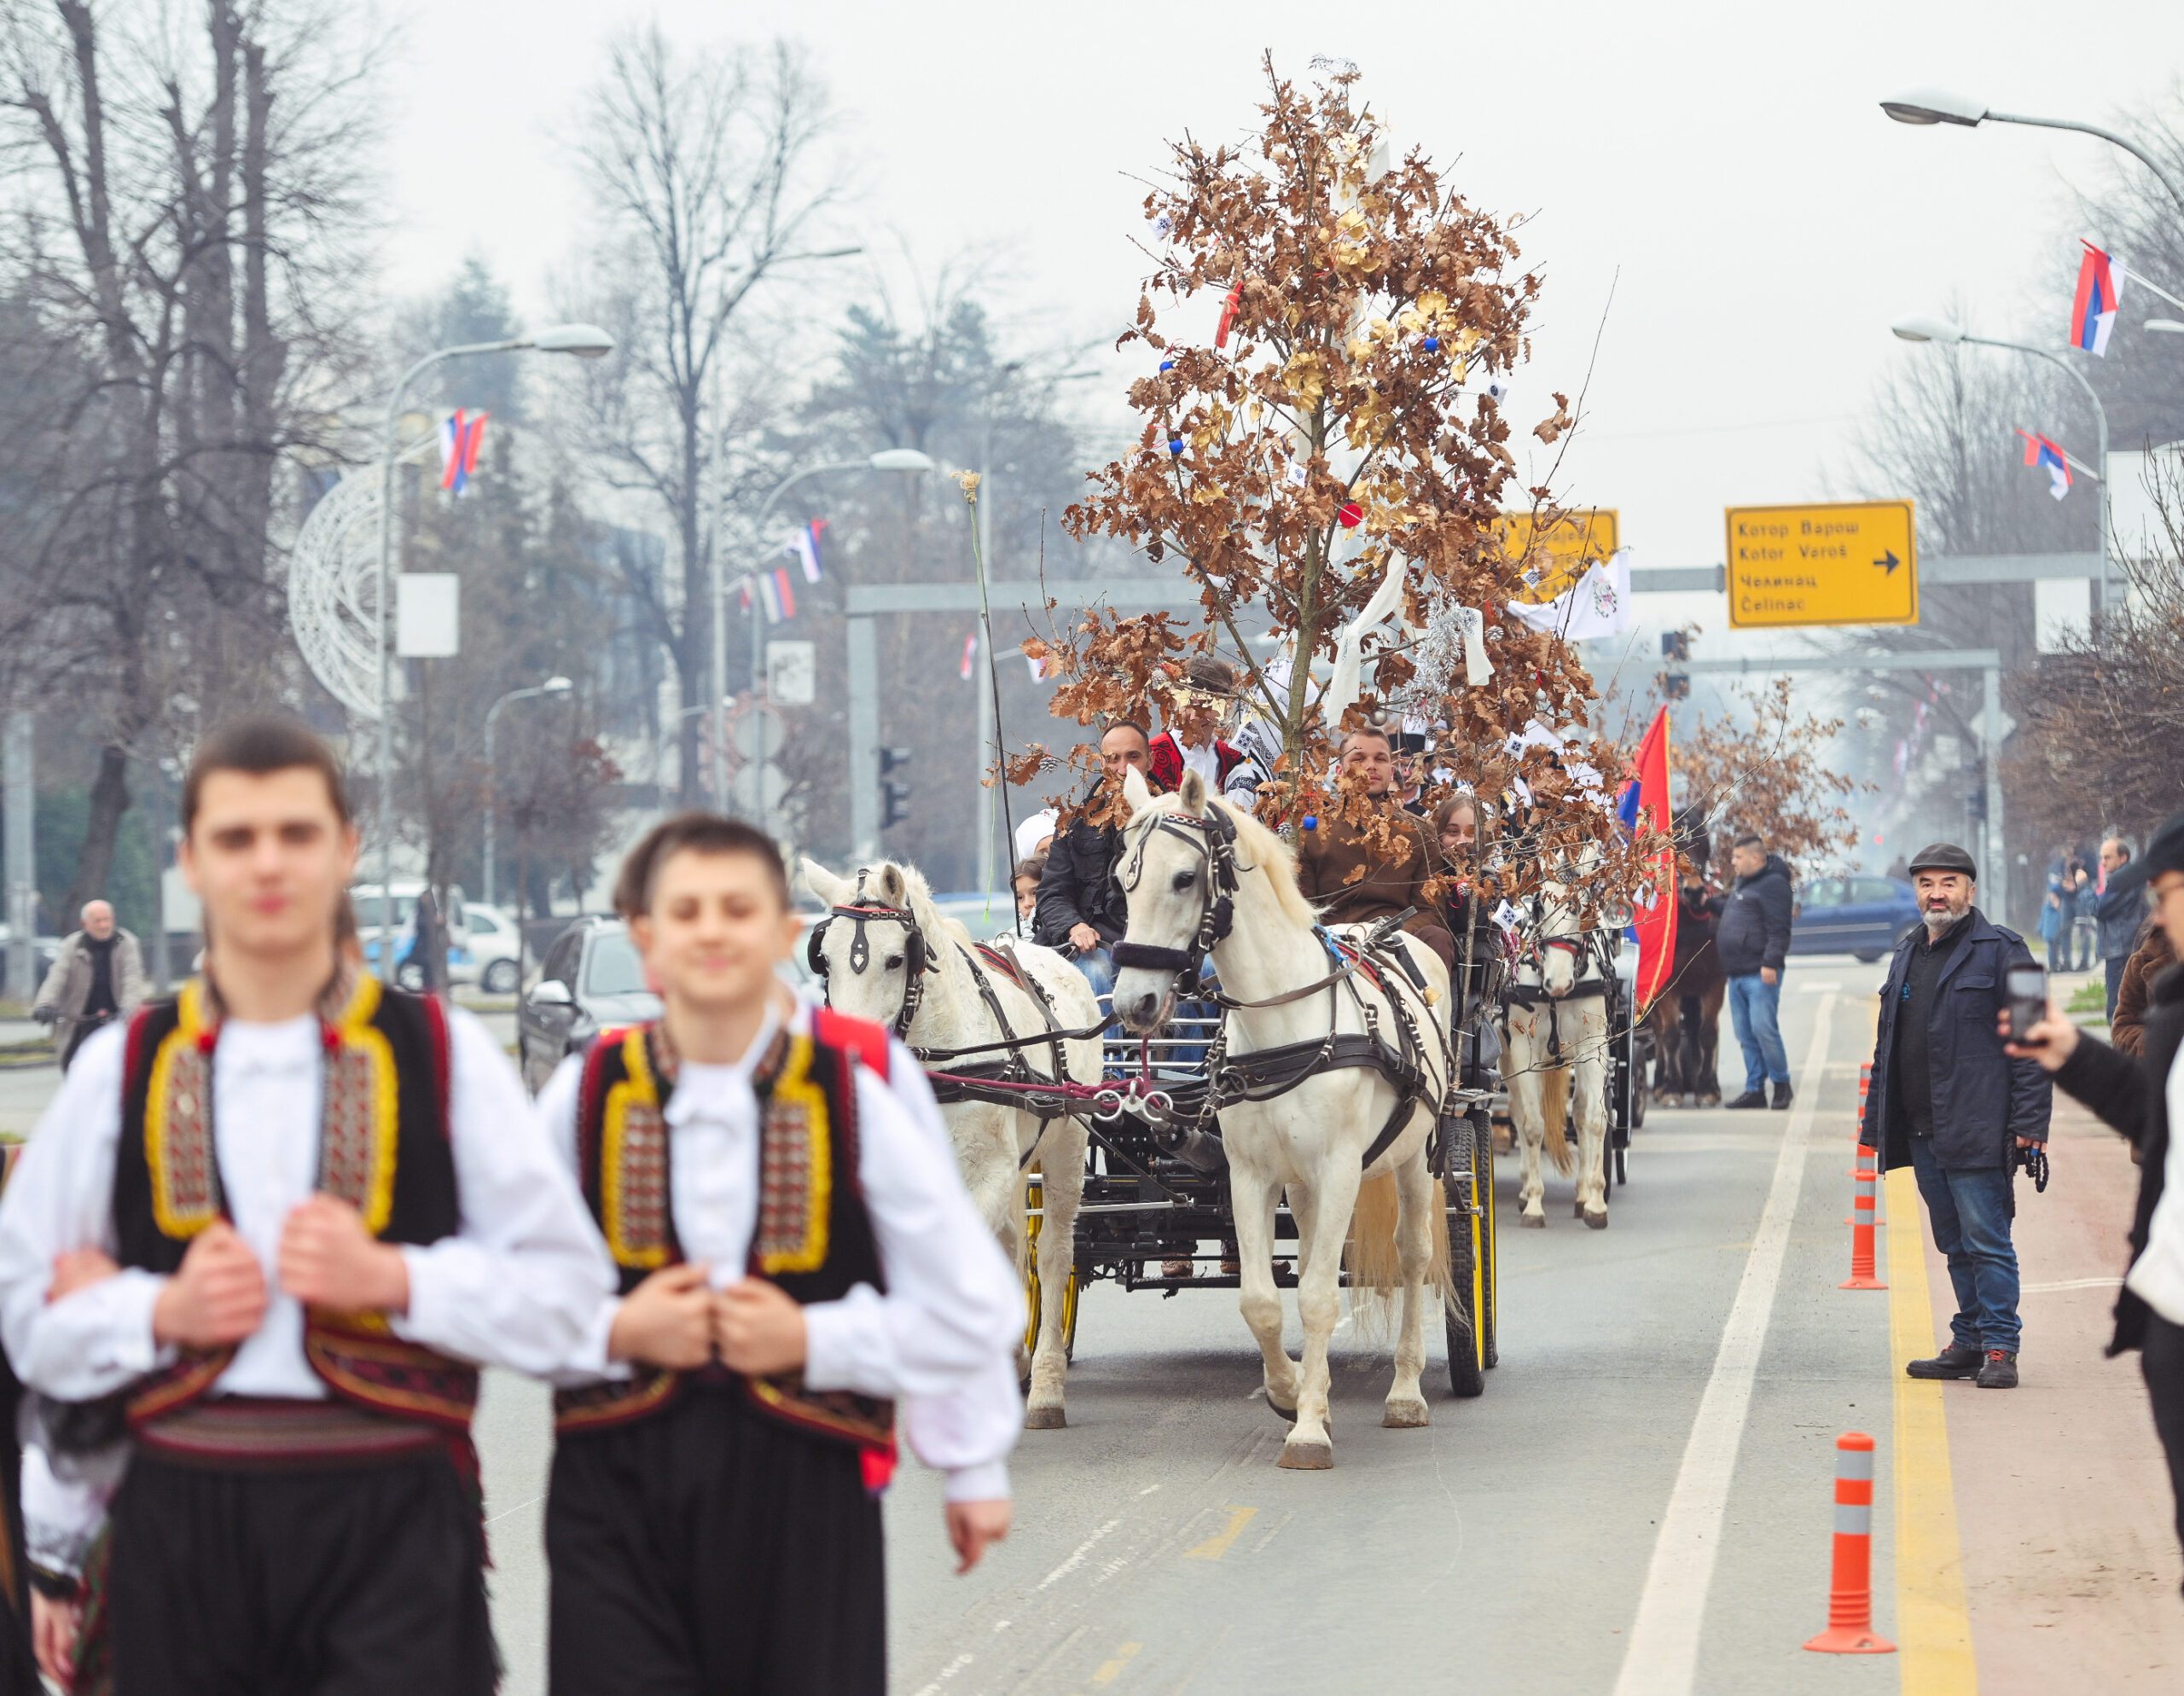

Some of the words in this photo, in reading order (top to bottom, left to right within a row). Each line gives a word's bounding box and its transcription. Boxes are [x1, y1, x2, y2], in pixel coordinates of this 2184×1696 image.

[1739, 523, 1789, 538] Котор
[1801, 520, 1860, 537] Варош
[1740, 547, 1784, 560] Kotor
[1798, 543, 1847, 559] Varoš
[1741, 596, 1805, 613] Čelinac
